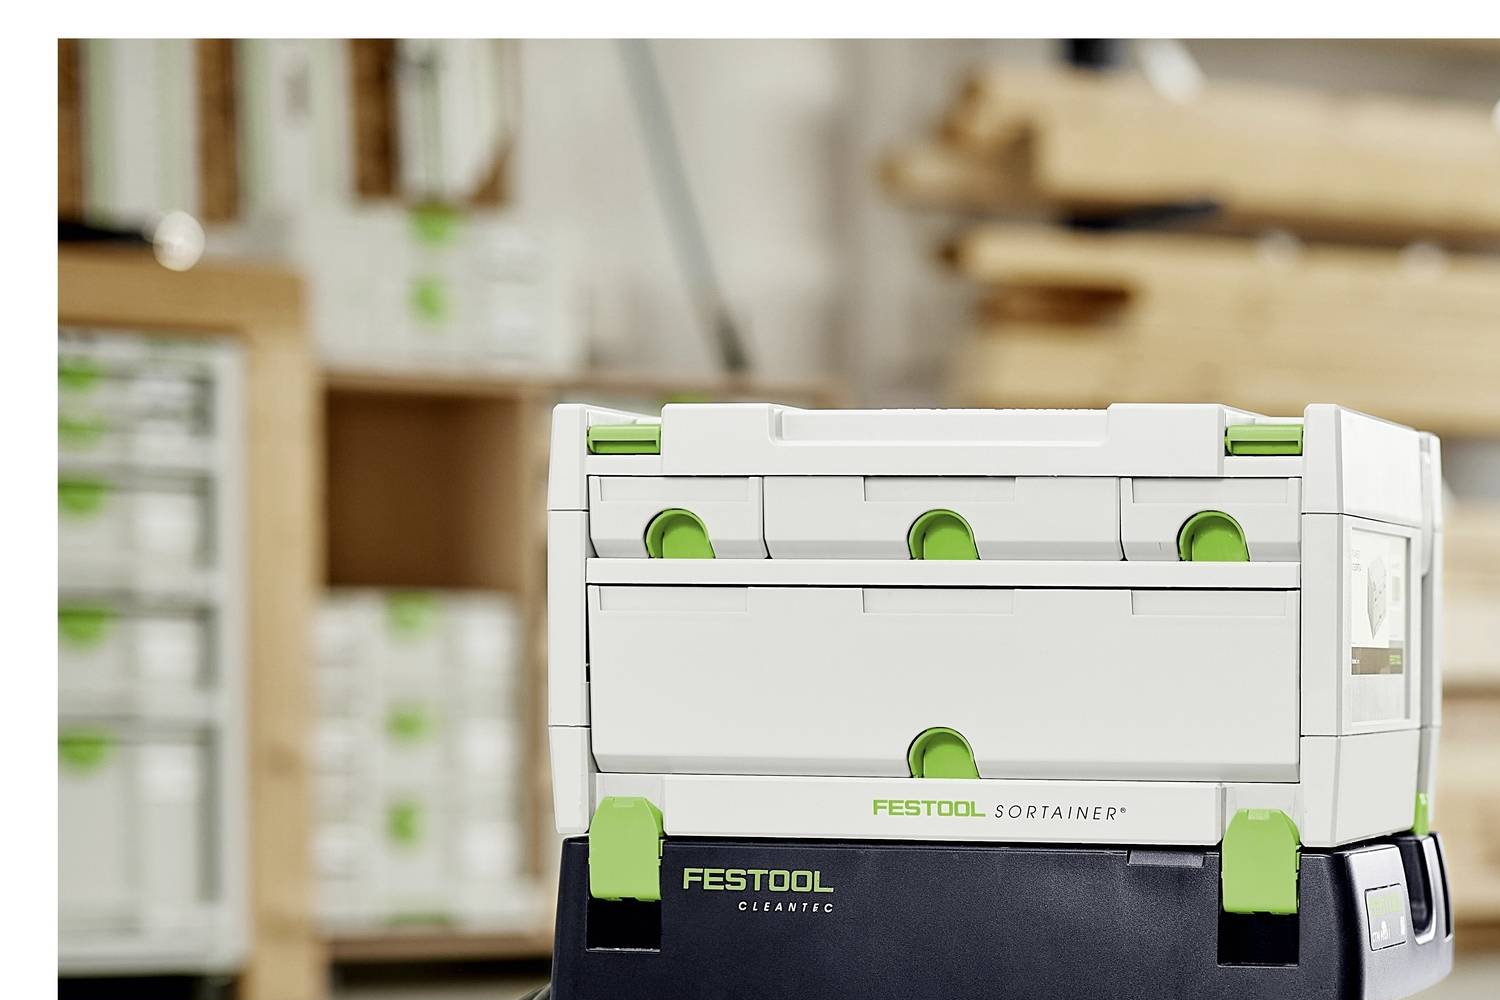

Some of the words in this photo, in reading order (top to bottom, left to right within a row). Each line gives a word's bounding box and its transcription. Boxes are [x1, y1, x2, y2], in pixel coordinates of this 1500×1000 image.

[873, 799, 986, 818] FESTOOL
[684, 868, 834, 893] FESTOOL
[739, 901, 834, 913] CLEANTEC
